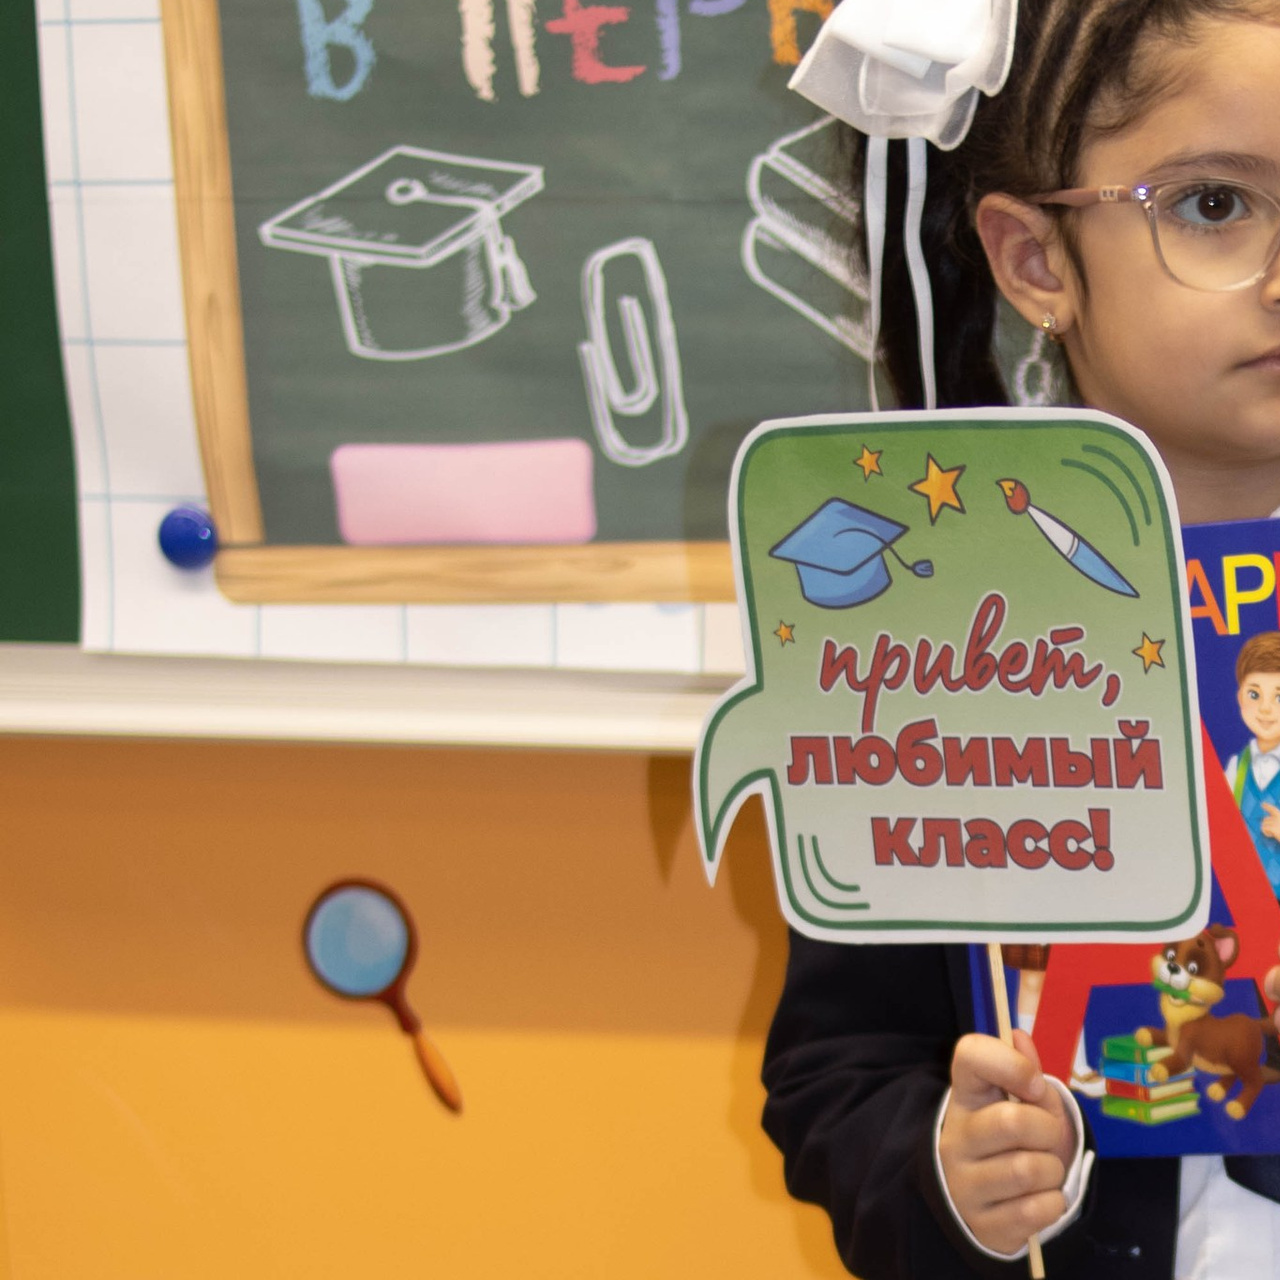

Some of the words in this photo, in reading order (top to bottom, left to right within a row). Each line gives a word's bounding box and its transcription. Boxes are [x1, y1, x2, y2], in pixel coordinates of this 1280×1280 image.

[819, 592, 1122, 734] привет,
[786, 717, 1164, 790] любимый
[869, 807, 1115, 872] класс!
